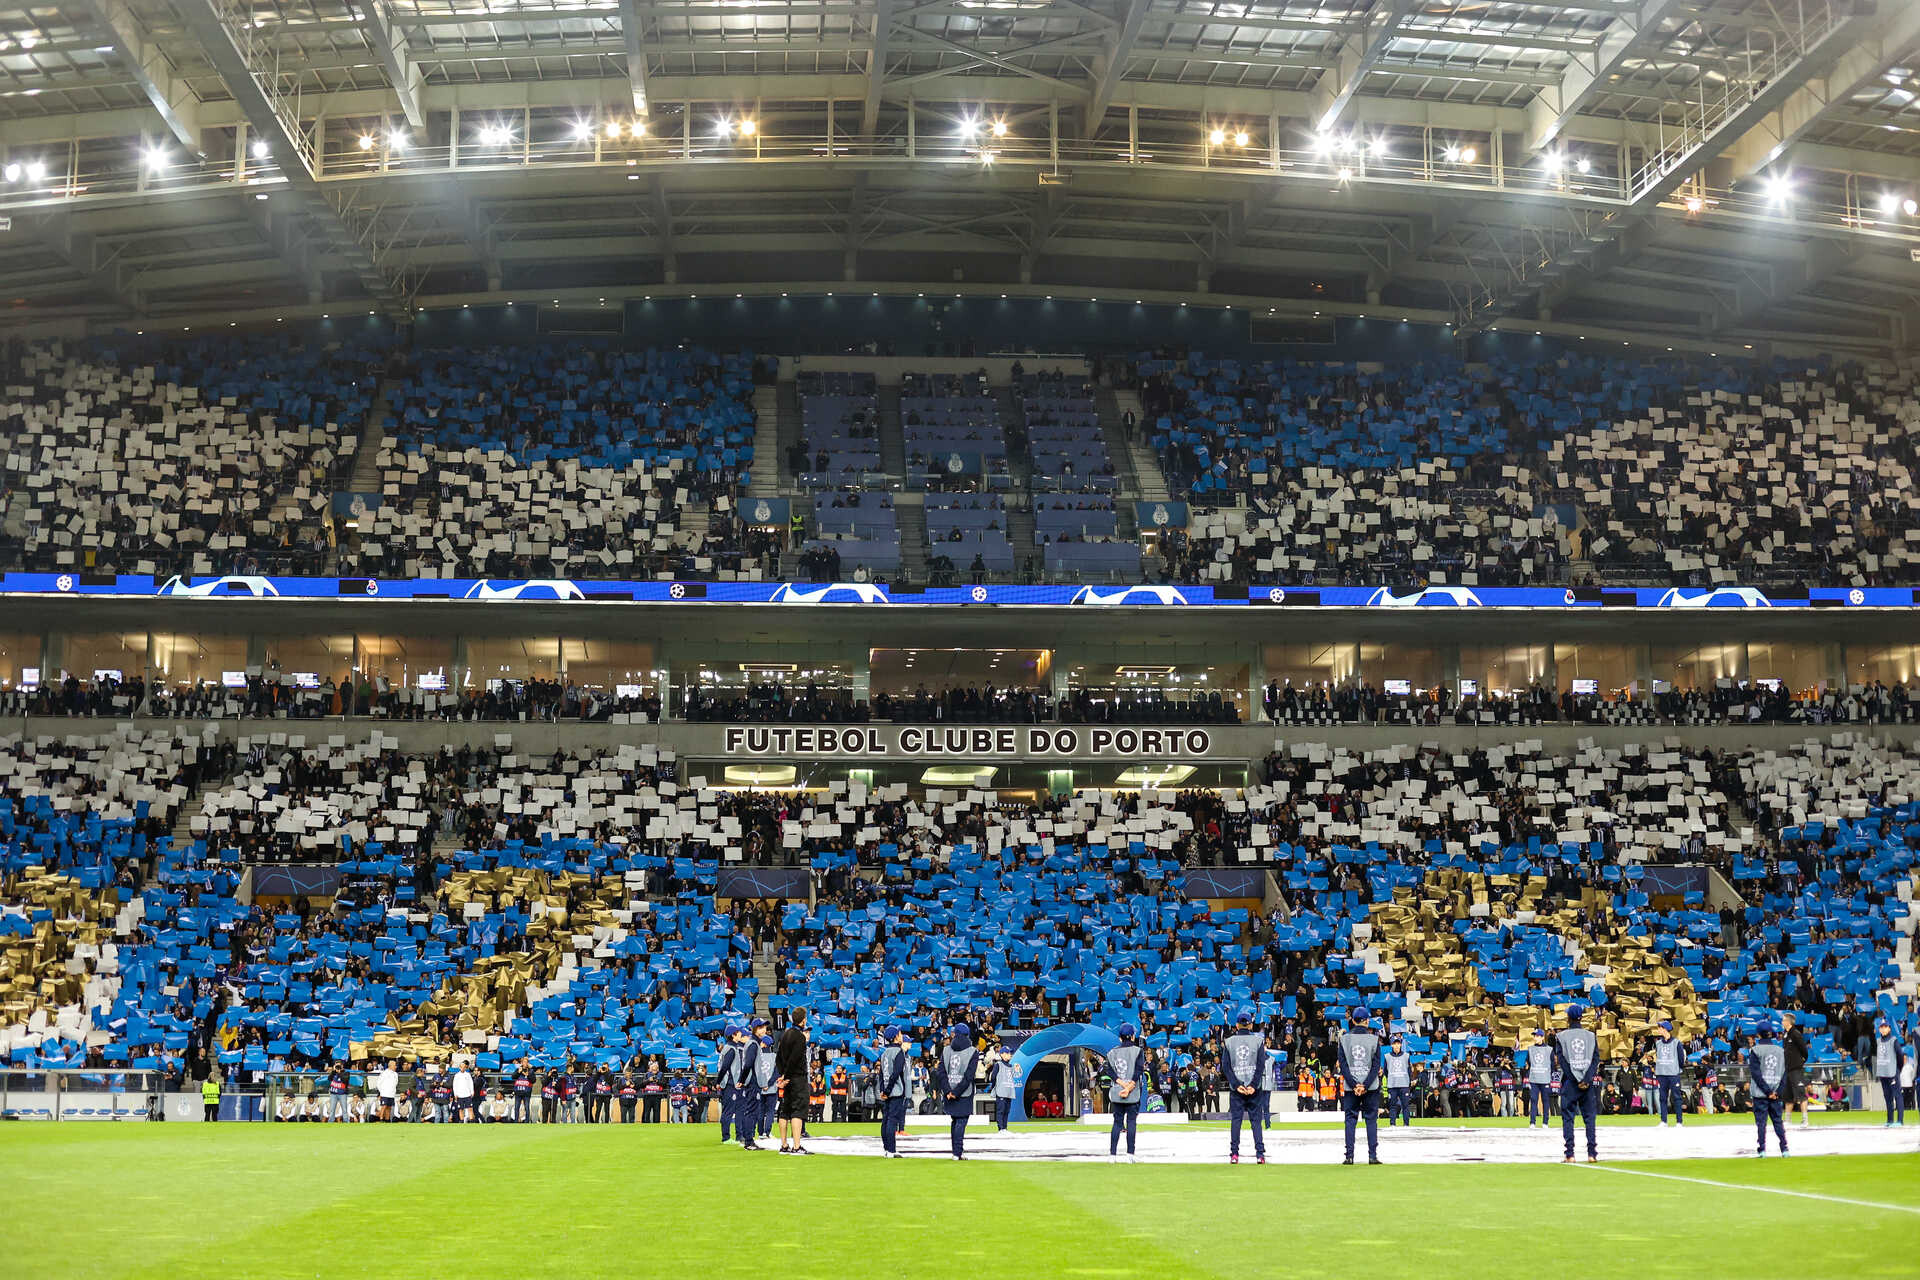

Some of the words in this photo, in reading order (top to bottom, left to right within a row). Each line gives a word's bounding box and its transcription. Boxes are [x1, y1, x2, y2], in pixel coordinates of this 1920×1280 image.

[725, 727, 887, 753] FUTEBOL
[899, 727, 1017, 754] CLUBE
[1029, 727, 1079, 755] DO
[1091, 727, 1211, 755] PORTO
